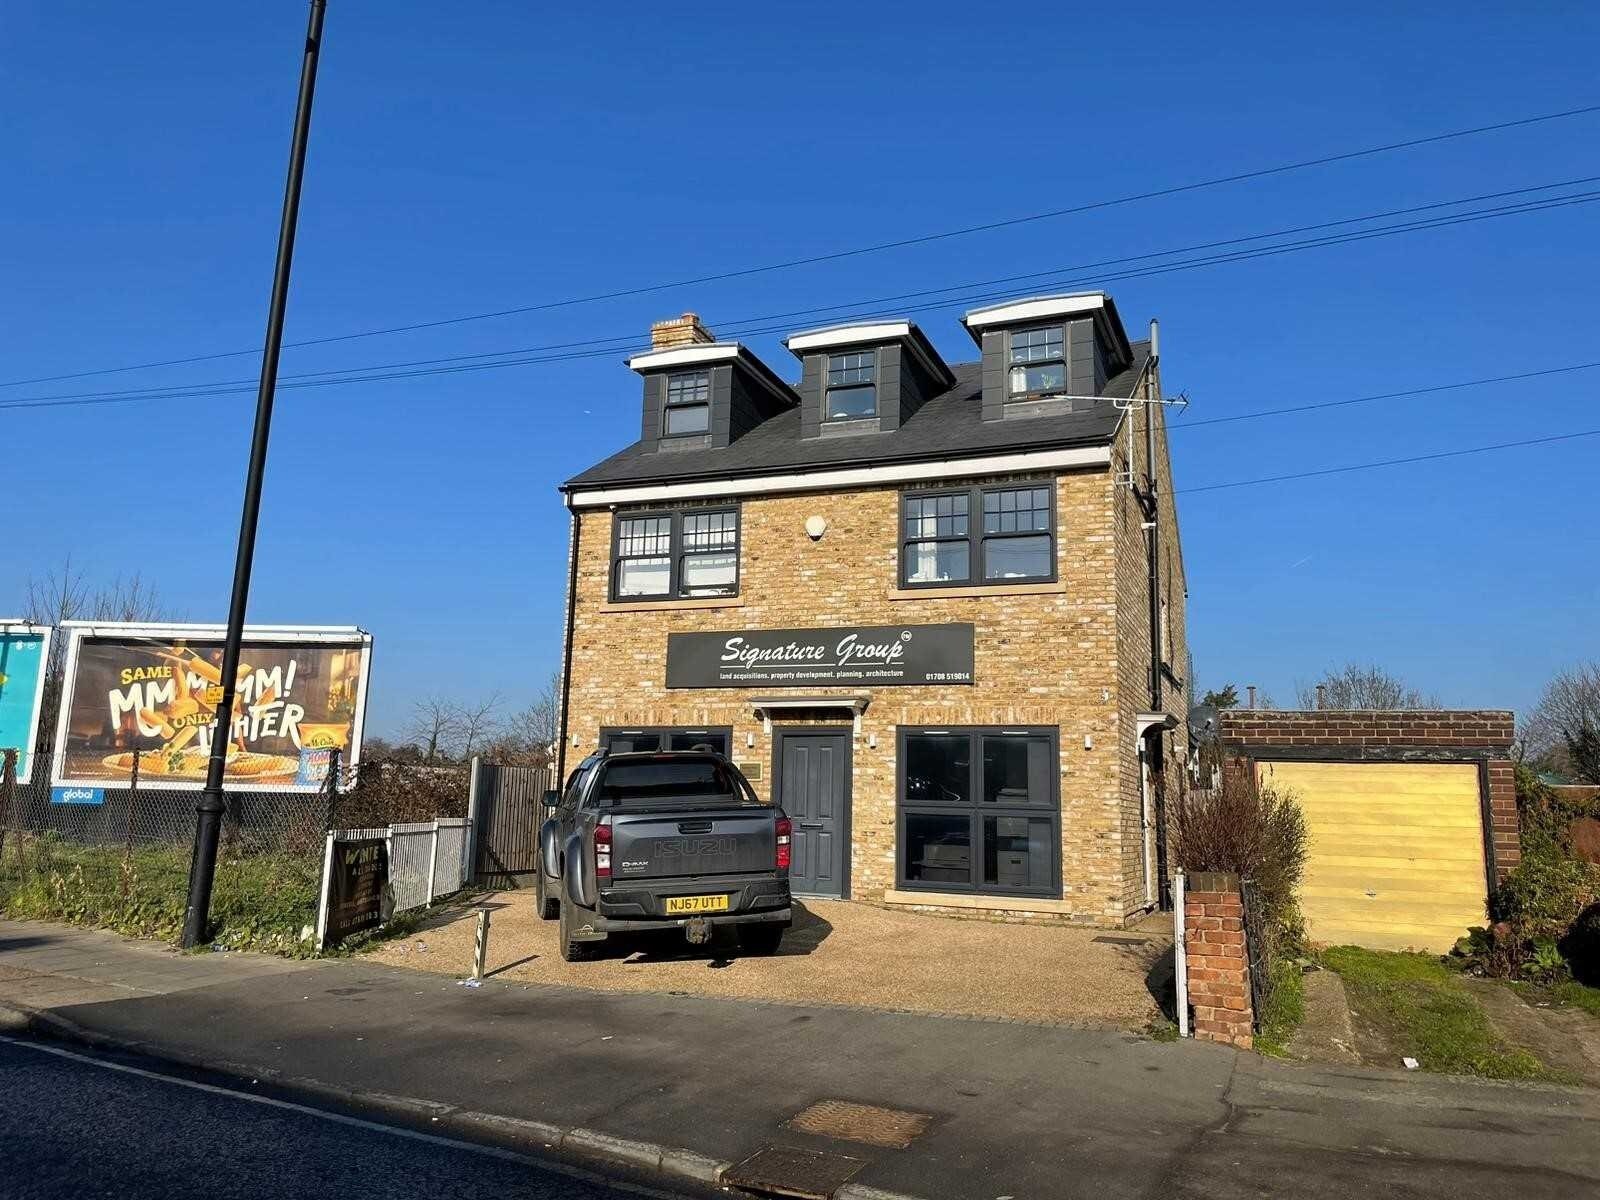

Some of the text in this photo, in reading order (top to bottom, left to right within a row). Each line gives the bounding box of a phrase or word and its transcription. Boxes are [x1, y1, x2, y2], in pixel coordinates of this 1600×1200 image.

[721, 634, 904, 669] Signature Group
[120, 666, 172, 684] SAME
[720, 672, 733, 680] land
[770, 671, 796, 680] property
[866, 669, 904, 677] architecture
[173, 712, 214, 729] ONLY
[198, 701, 303, 757] LIHTER
[63, 788, 94, 802] global
[653, 838, 738, 858] ISUZU
[670, 896, 723, 911] NJ67 UTT
